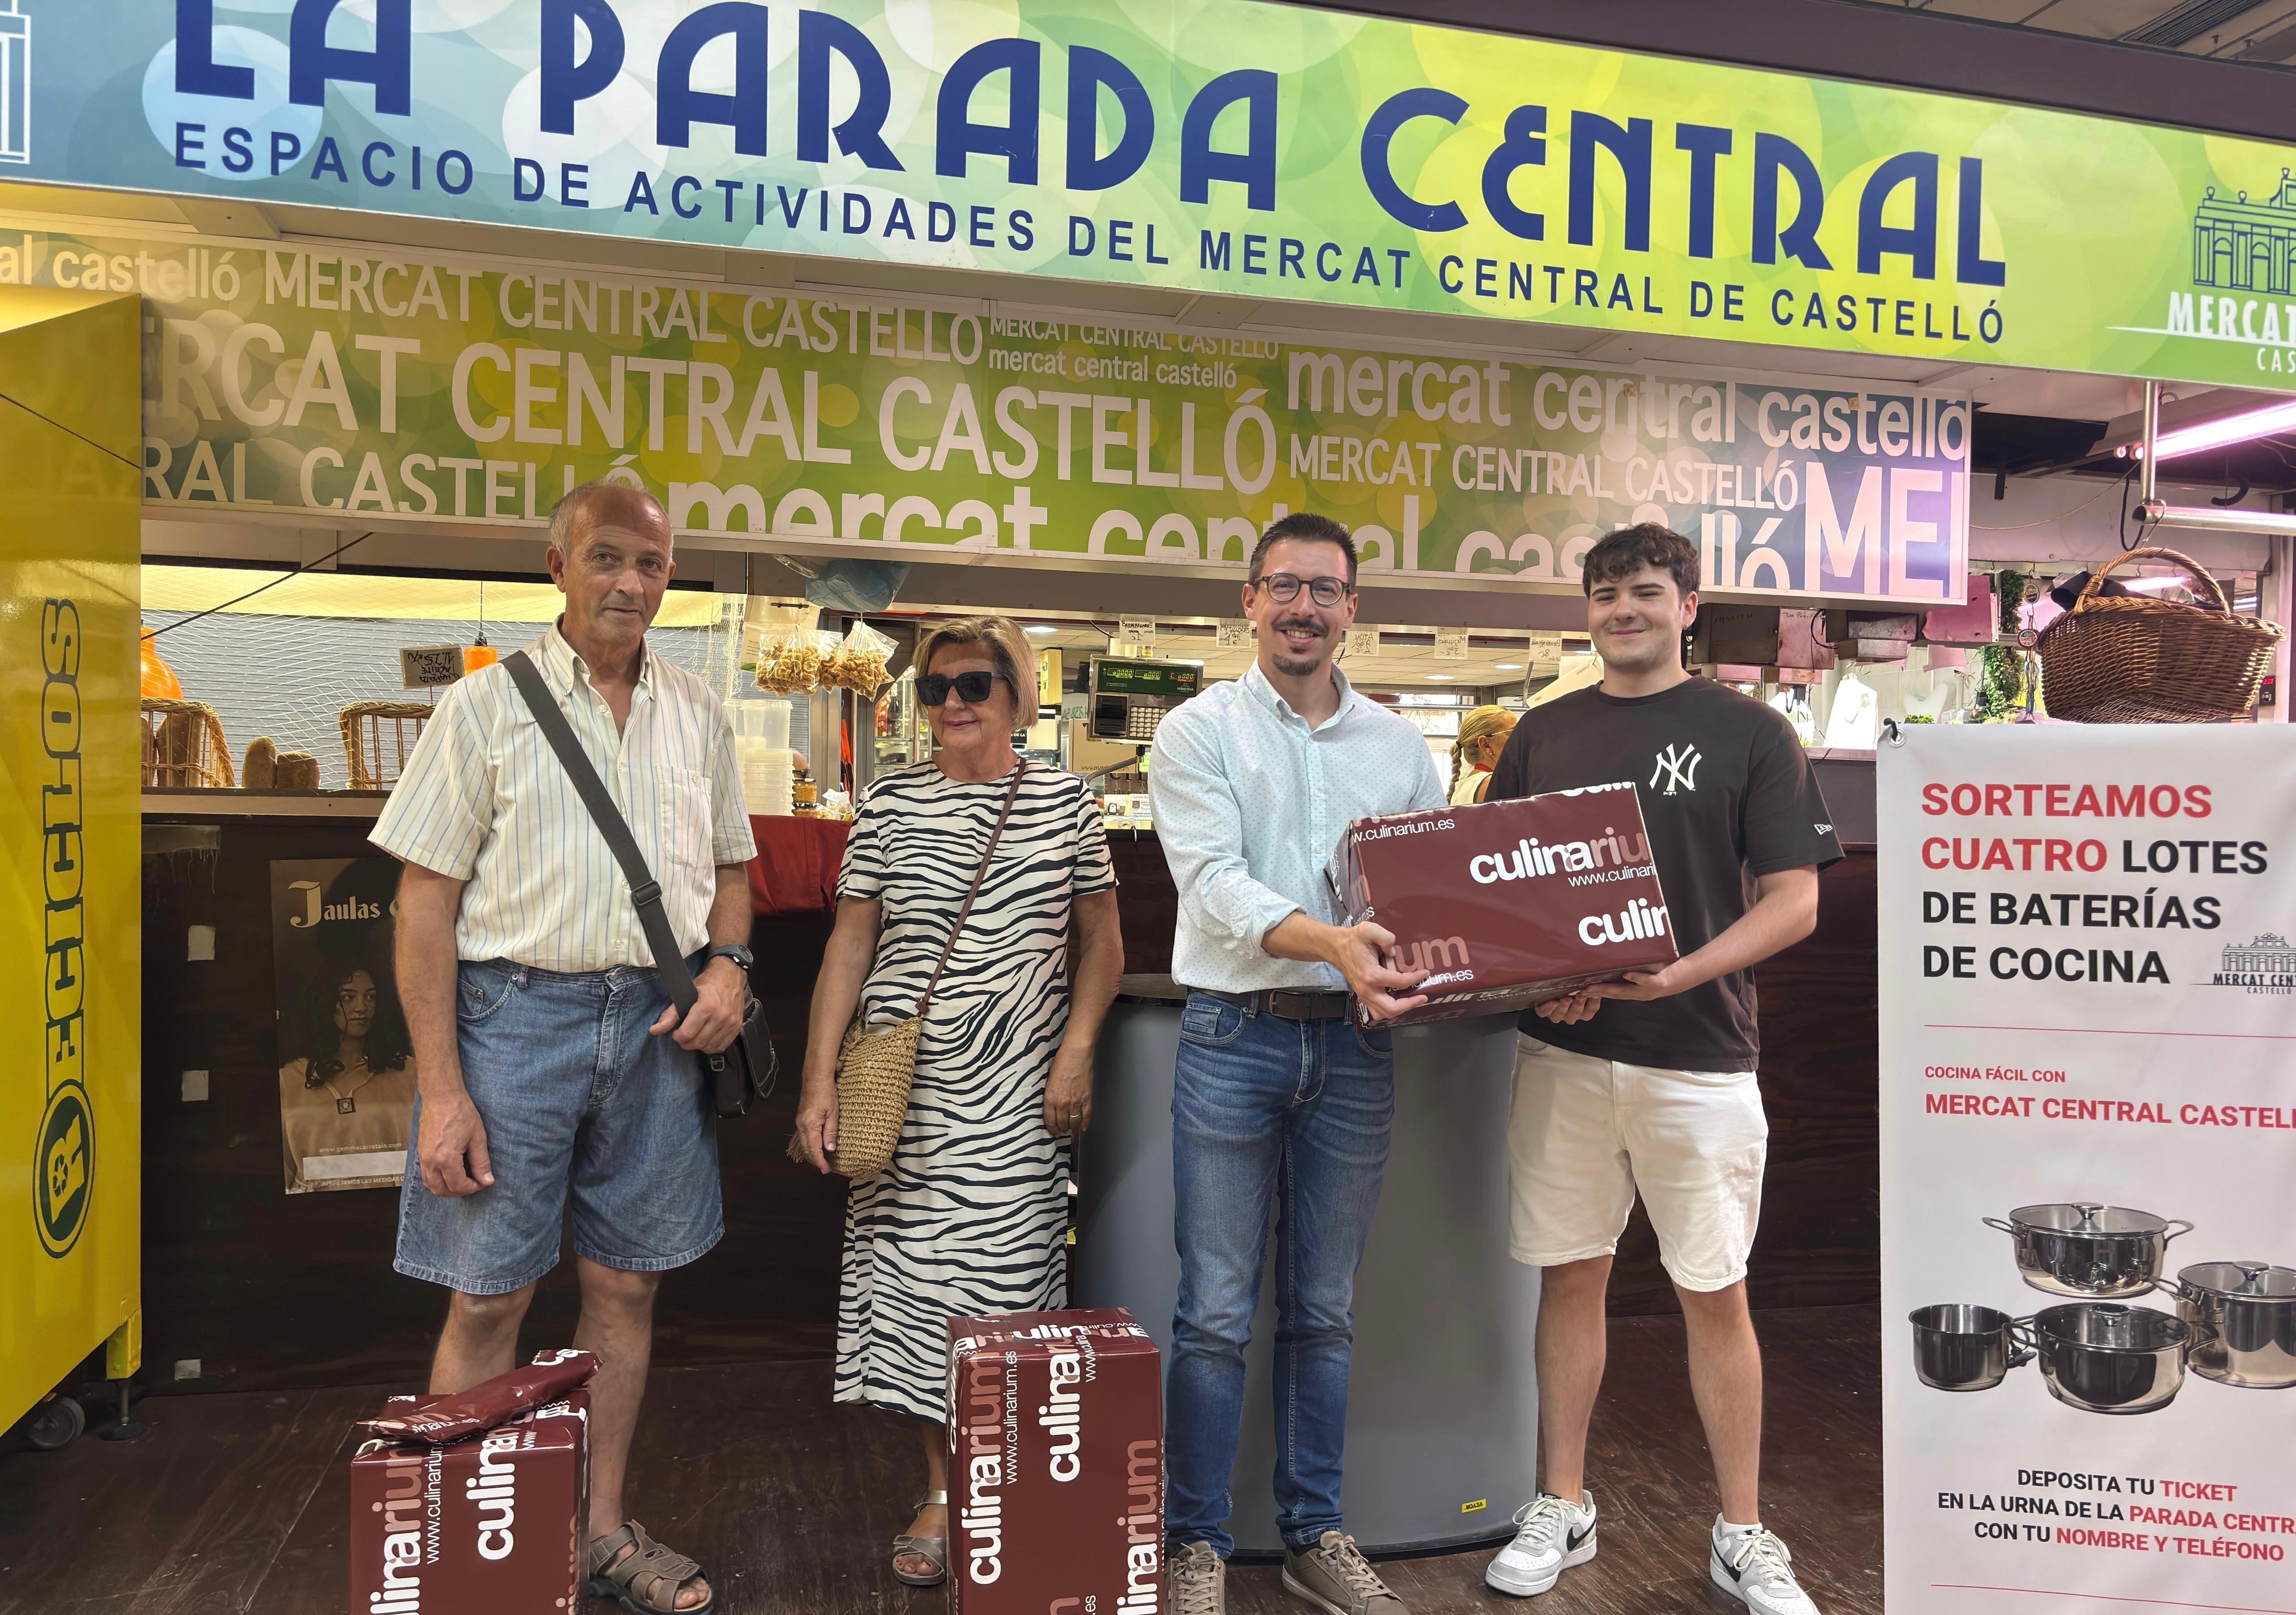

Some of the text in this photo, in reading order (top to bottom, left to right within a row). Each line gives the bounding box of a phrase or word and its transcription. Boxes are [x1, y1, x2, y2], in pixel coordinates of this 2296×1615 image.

[175, 0, 2006, 287] LA PARADA CENTRAL
[176, 122, 2003, 344] ESPACIO DE ACTIVIDADES DEL MERCAT CENTRAL DE CASTELLÓ
[53, 248, 240, 301] castelló
[266, 251, 482, 321] MERCAT
[500, 274, 727, 343] CENTRAL
[990, 317, 1069, 341] MERCAT
[1080, 325, 1172, 351] CENTRAL
[989, 348, 1237, 389] mercat central castelló
[1288, 351, 1511, 426] mercat
[1534, 372, 1735, 443] central
[452, 342, 851, 465] CENTRAL
[879, 377, 1276, 495] CASTELLÓ
[1290, 433, 1798, 512] MERCAT CENTRAL CASTELLÓ
[1649, 743, 1702, 791] NY
[1921, 783, 2212, 818] SORTEAMOS
[1922, 837, 2268, 875] CUATRO LOTES
[288, 881, 380, 928] Jaulas
[1923, 887, 2221, 930] DE BATERÍAS
[1923, 945, 2170, 984] DE COCINA
[2213, 973, 2296, 986] MERCAT CEN
[1925, 1065, 2066, 1083] COCINA FÁCIL CON
[1926, 1093, 2035, 1118] MERCAT
[2042, 1098, 2172, 1124] CENTRAL
[1003, 1351, 1018, 1485] www.culinarium.es
[961, 1352, 1001, 1585] culinarium
[2017, 1469, 2238, 1502] DEPOSITA TU TICKET
[1938, 1492, 1963, 1509] EN
[1969, 1494, 1995, 1511] LA
[2001, 1495, 2059, 1516] URNA
[2065, 1500, 2091, 1518] DE
[2097, 1503, 2124, 1521] LA
[2130, 1505, 2218, 1528] PARADA
[1974, 1522, 2284, 1561] CON TU NOMBRE Y TELÉFONO
